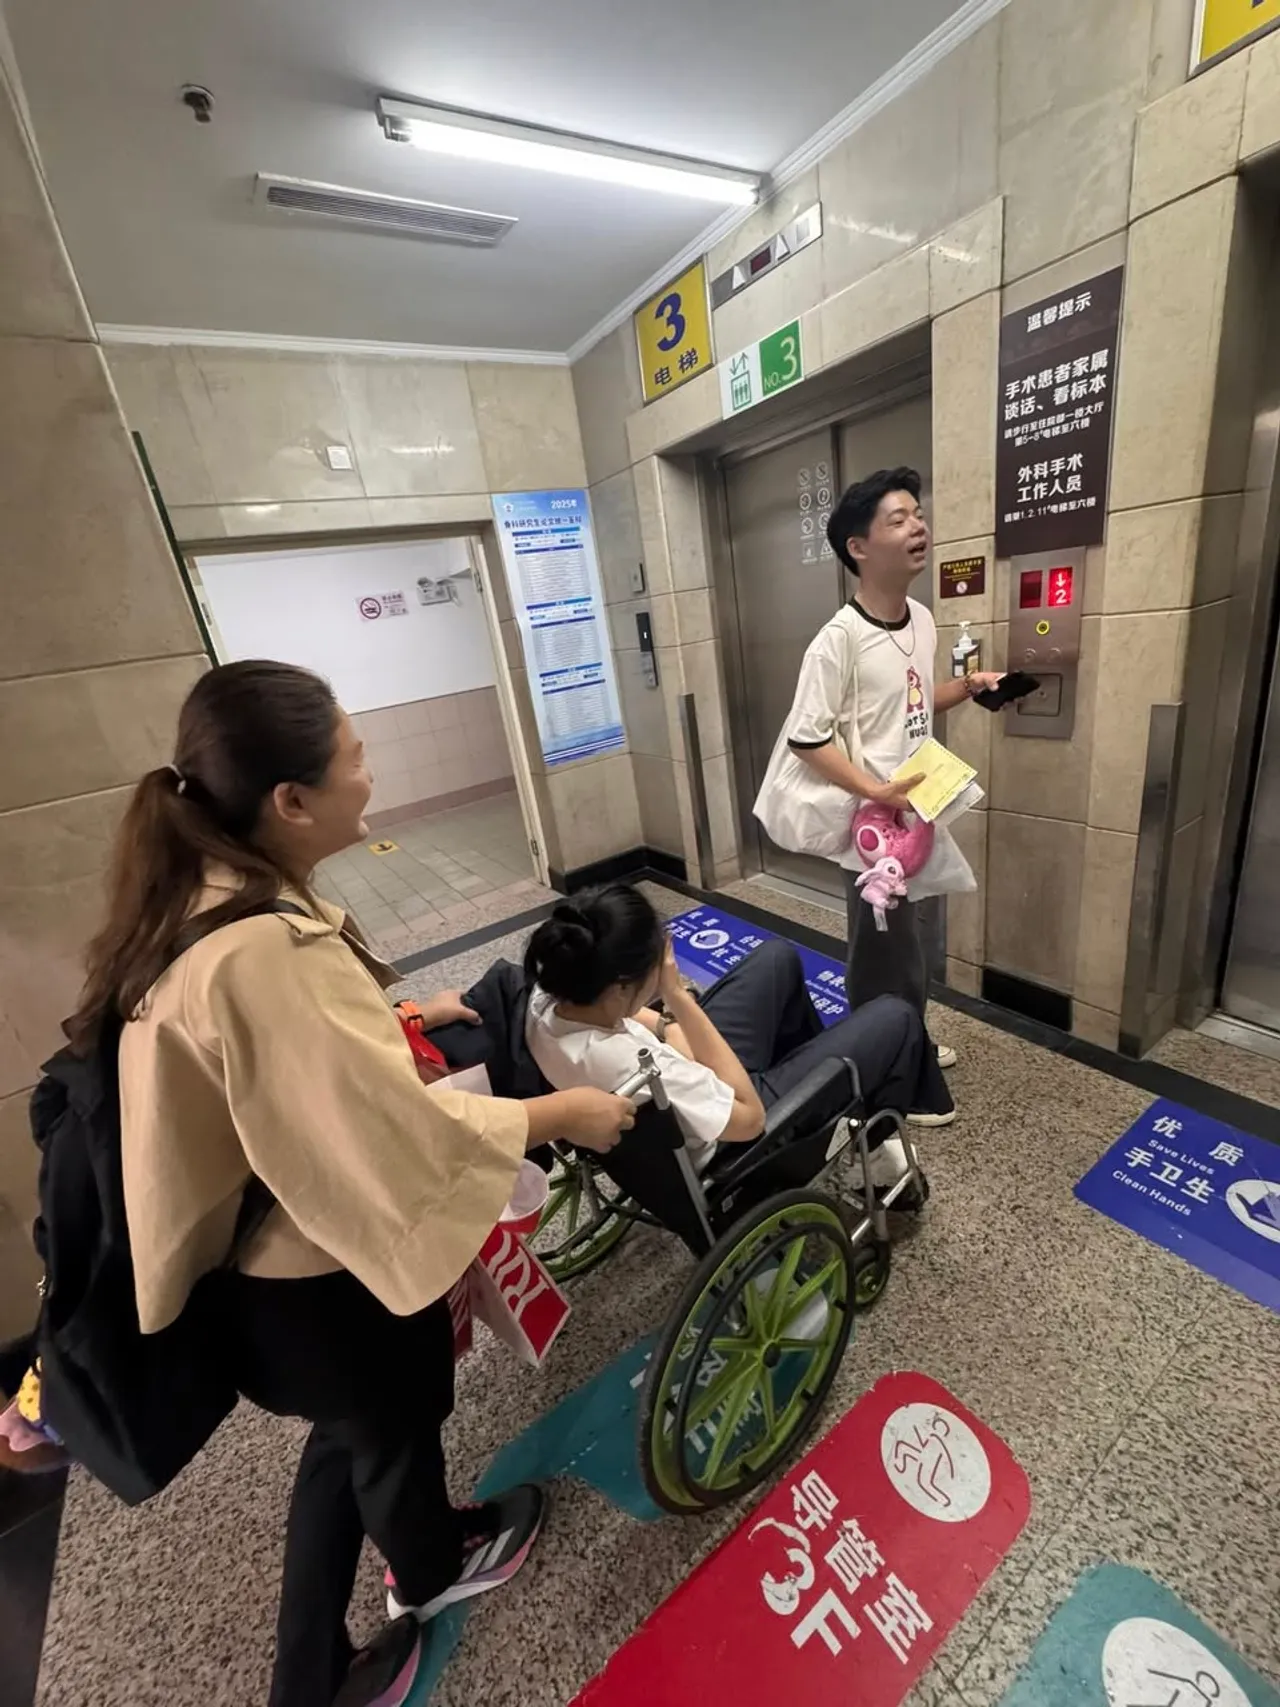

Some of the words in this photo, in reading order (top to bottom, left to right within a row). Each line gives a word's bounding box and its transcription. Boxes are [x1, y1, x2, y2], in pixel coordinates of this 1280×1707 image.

[655, 292, 686, 352] 3
[1026, 291, 1092, 333] 温馨提示
[654, 347, 698, 385] 电梯
[1005, 348, 1109, 400] 手术患者家属
[1004, 374, 1107, 421] 谈话、看标本
[1017, 453, 1083, 484] 外科手术
[1017, 475, 1082, 503] 工作人员
[1055, 589, 1067, 604] 2
[1124, 1147, 1215, 1204] 手卫生
[1148, 1139, 1178, 1158] Save
[1180, 1154, 1215, 1175] Lives
[1112, 1170, 1147, 1193] Clean
[1149, 1188, 1192, 1216] Hands
[790, 1469, 934, 1664] 导管室
